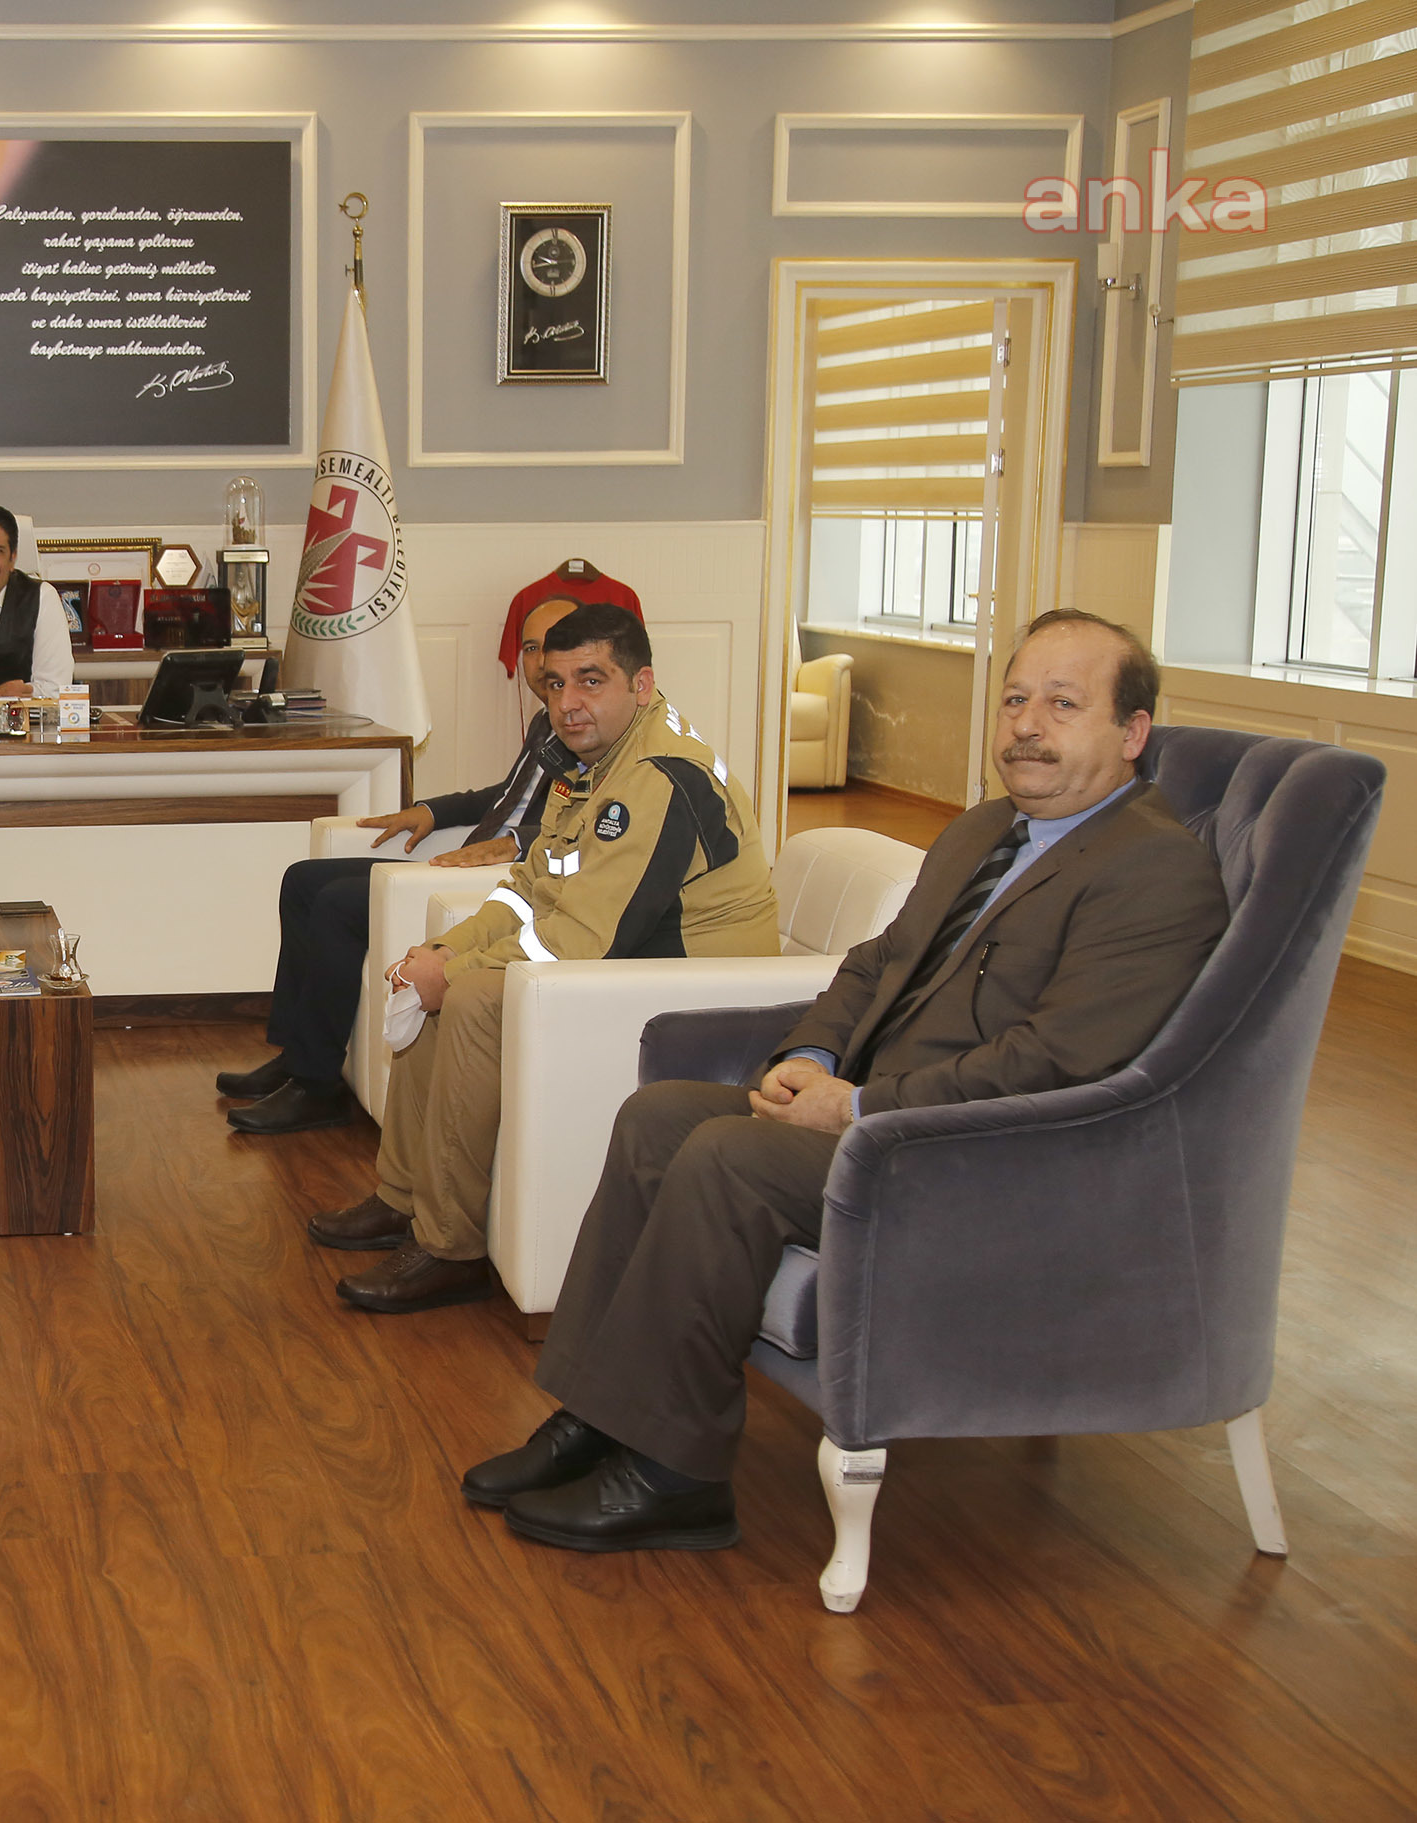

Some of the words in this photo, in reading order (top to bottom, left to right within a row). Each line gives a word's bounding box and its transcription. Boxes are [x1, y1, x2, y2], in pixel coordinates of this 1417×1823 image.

[81, 206, 162, 225] yorulmadan,
[167, 207, 244, 226] öğrenmeden,
[44, 232, 82, 248] rahat
[84, 237, 135, 252] yaşama
[138, 233, 195, 251] yollarını
[21, 262, 60, 279] itiyat
[62, 259, 103, 275] haline
[105, 262, 158, 280] getirmiş
[161, 260, 217, 275] milletler
[30, 286, 121, 306] haysiyetlerini,
[126, 290, 163, 302] sonra
[165, 286, 252, 306] hürriyetlerini
[31, 318, 48, 329] ve
[50, 313, 84, 329] daha
[86, 317, 123, 329] sonra
[125, 313, 207, 329] istiklallerini
[30, 339, 104, 359] kaybetmeye
[105, 339, 206, 356] mahkumdurlar.
[315, 456, 395, 505] SEMEALTI
